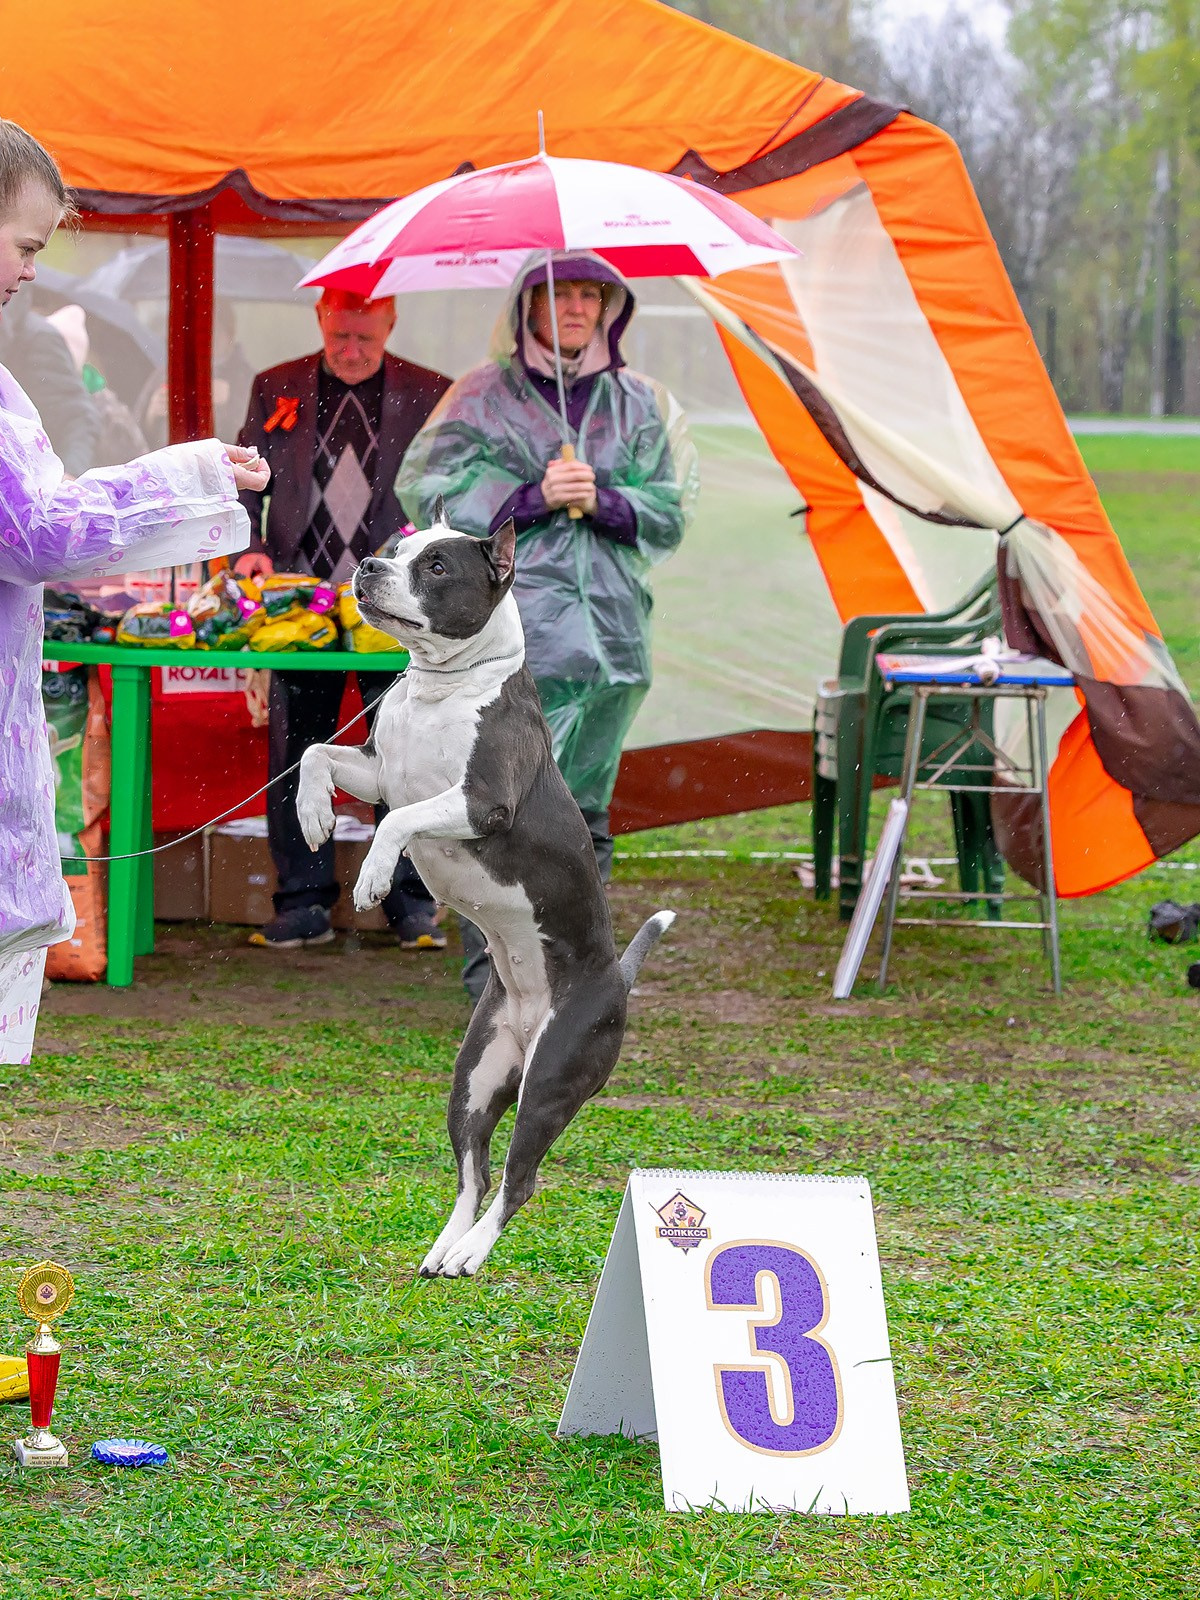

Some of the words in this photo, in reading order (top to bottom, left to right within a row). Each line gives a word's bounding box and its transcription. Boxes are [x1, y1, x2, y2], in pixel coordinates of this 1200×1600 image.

[168, 666, 229, 681] ROYAL
[660, 1229, 707, 1237] ООПККСС
[704, 1238, 844, 1458] 3
